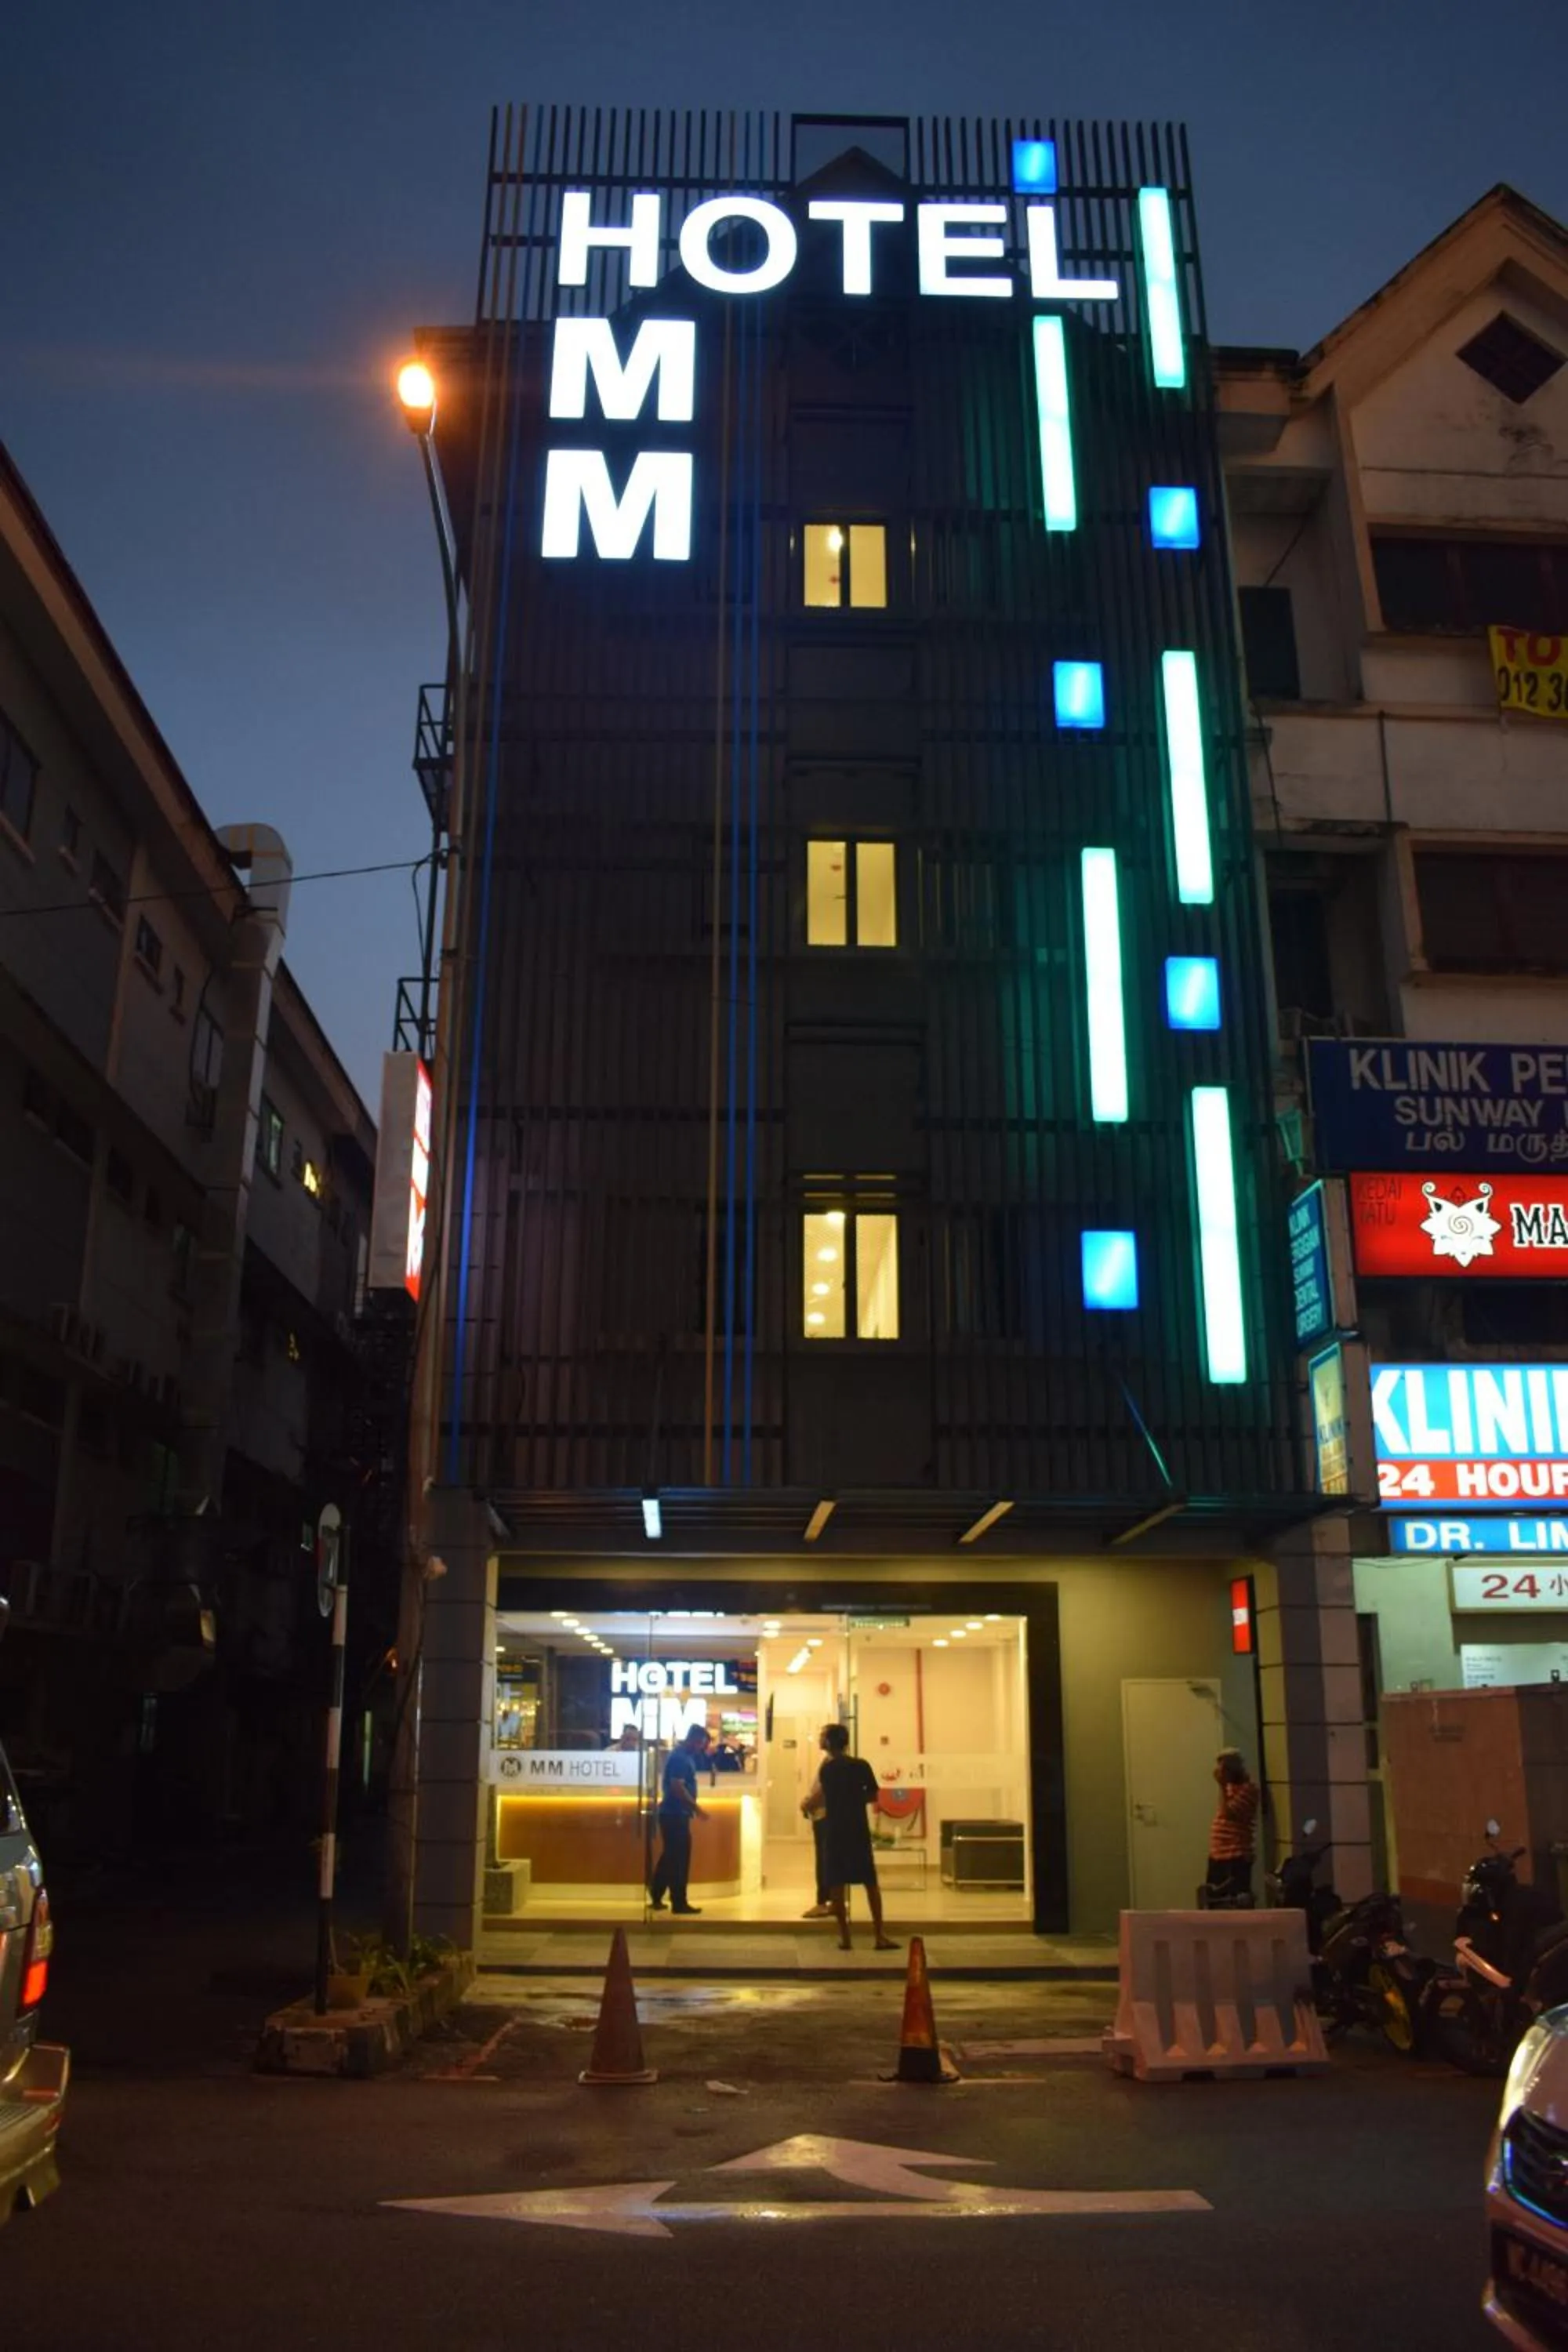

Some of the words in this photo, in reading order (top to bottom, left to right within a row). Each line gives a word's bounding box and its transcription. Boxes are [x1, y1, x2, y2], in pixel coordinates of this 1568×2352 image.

[558, 192, 1119, 299] HOTEL
[1497, 629, 1560, 666] TO
[1497, 666, 1538, 707] 012
[1348, 1047, 1491, 1092] KLINIK
[1510, 1052, 1568, 1094] PE
[1394, 1095, 1544, 1127] SUNWAY
[1377, 1464, 1435, 1497] 24
[1405, 1522, 1484, 1549] DR.
[1482, 1573, 1541, 1599] 24
[612, 1661, 739, 1694] HOTEL
[569, 1760, 621, 1777] HOTEL
